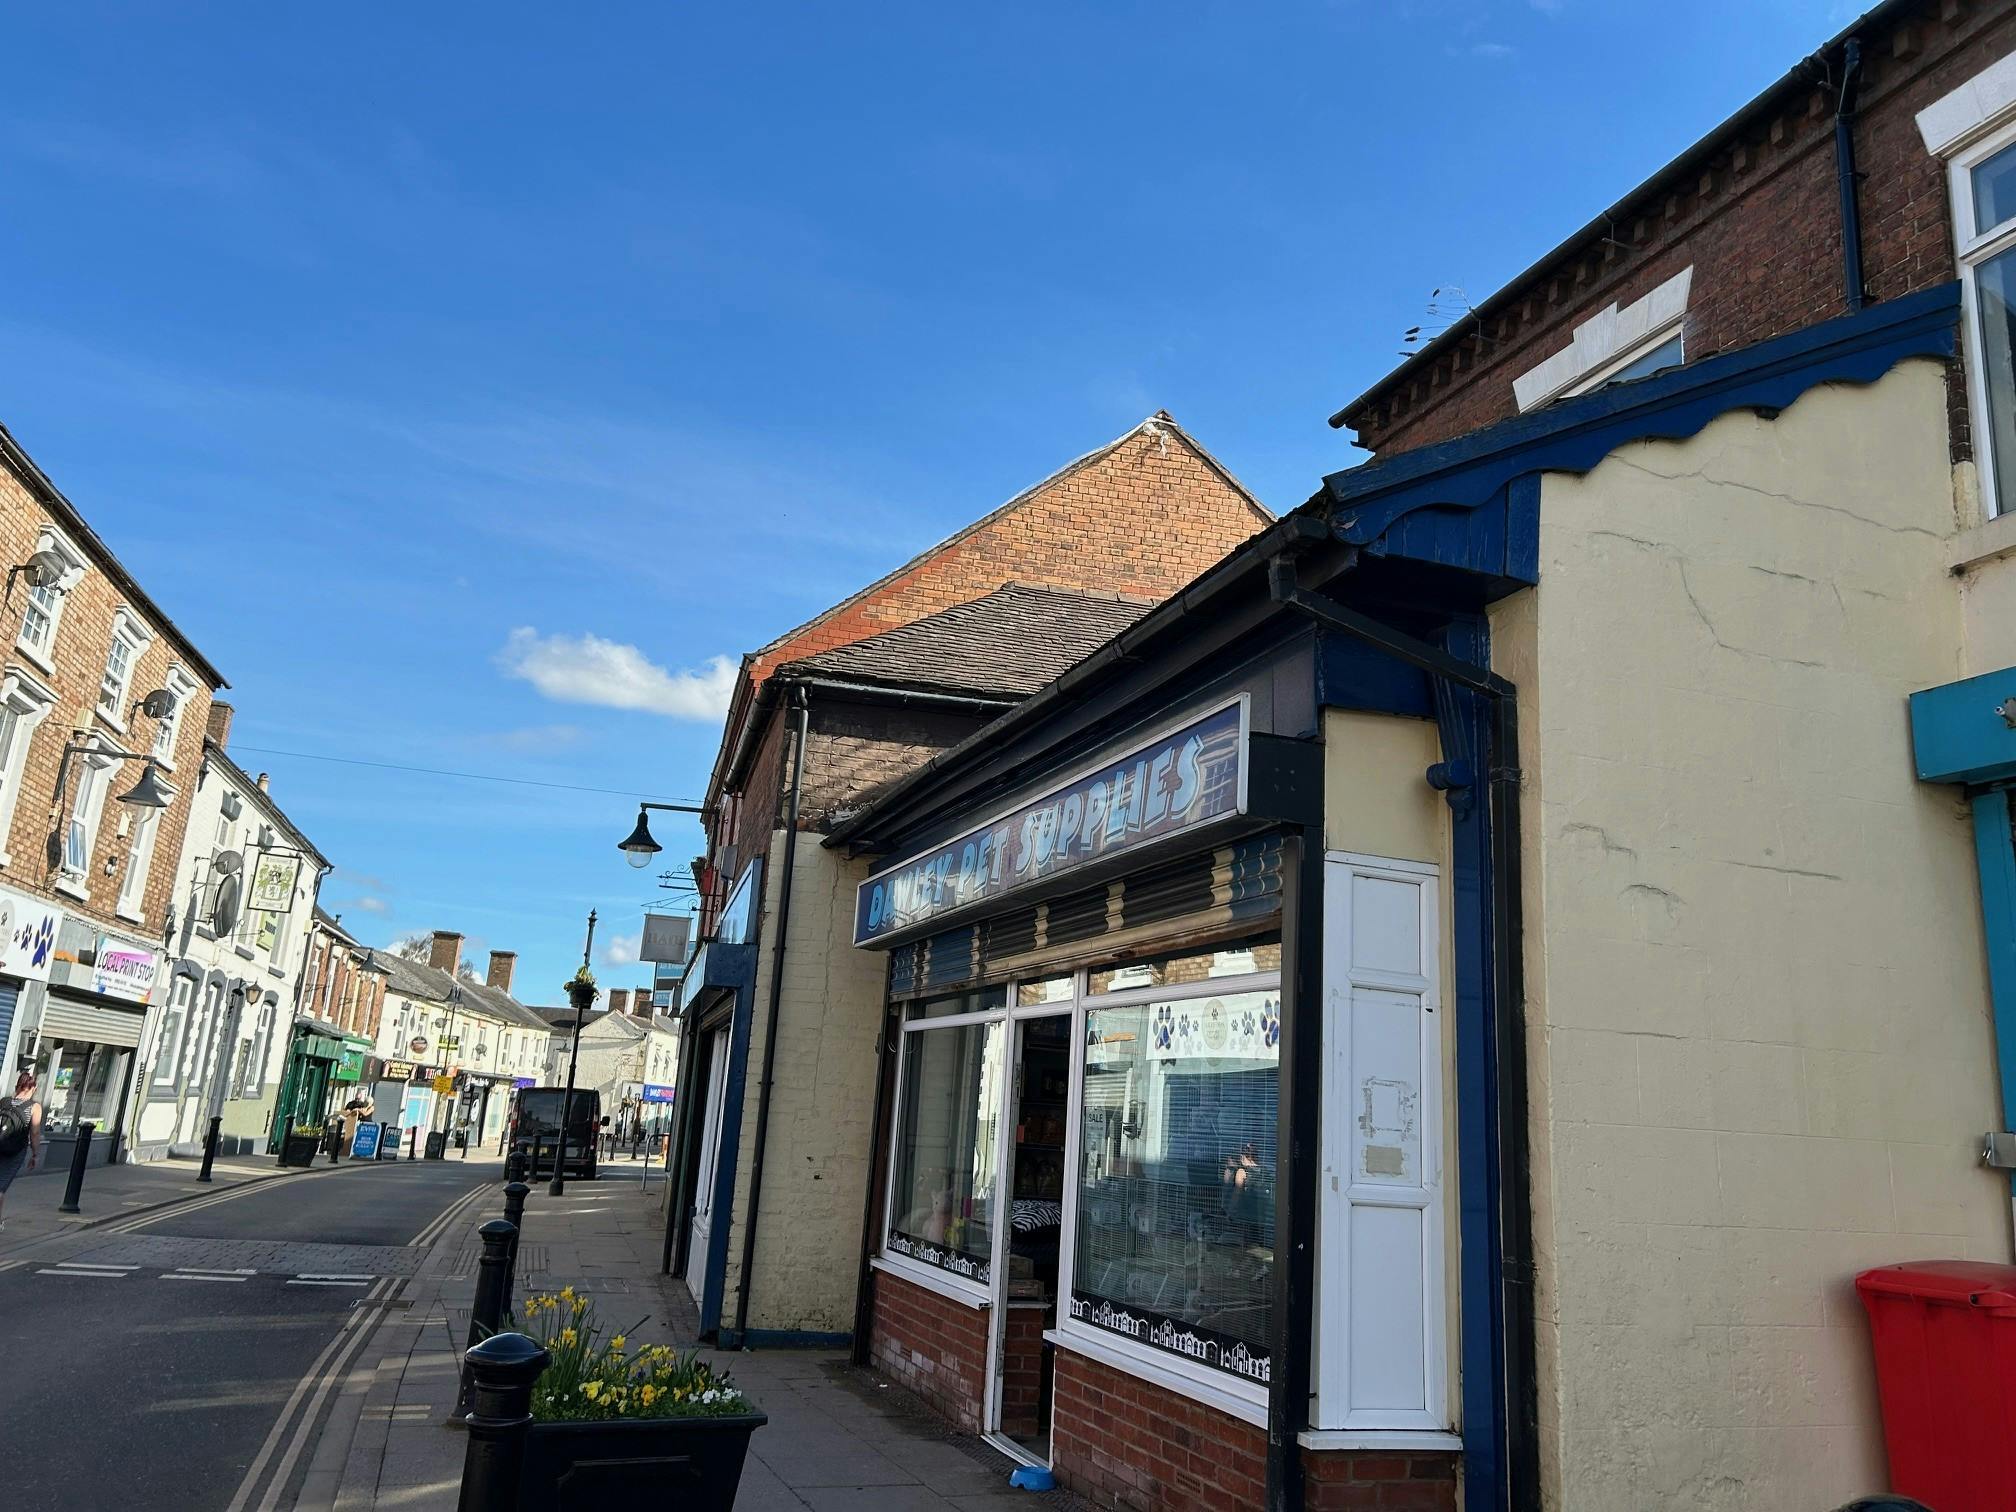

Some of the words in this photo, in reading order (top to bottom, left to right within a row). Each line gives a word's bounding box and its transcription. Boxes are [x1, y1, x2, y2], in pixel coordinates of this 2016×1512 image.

[868, 852, 955, 932] DAWLEY
[956, 826, 1012, 900] PET
[1015, 735, 1204, 877] SUPPLIES
[97, 951, 121, 973] LOCAL
[119, 957, 139, 978] PRINT
[137, 963, 155, 982] STOP
[1088, 1113, 1103, 1122] SALE
